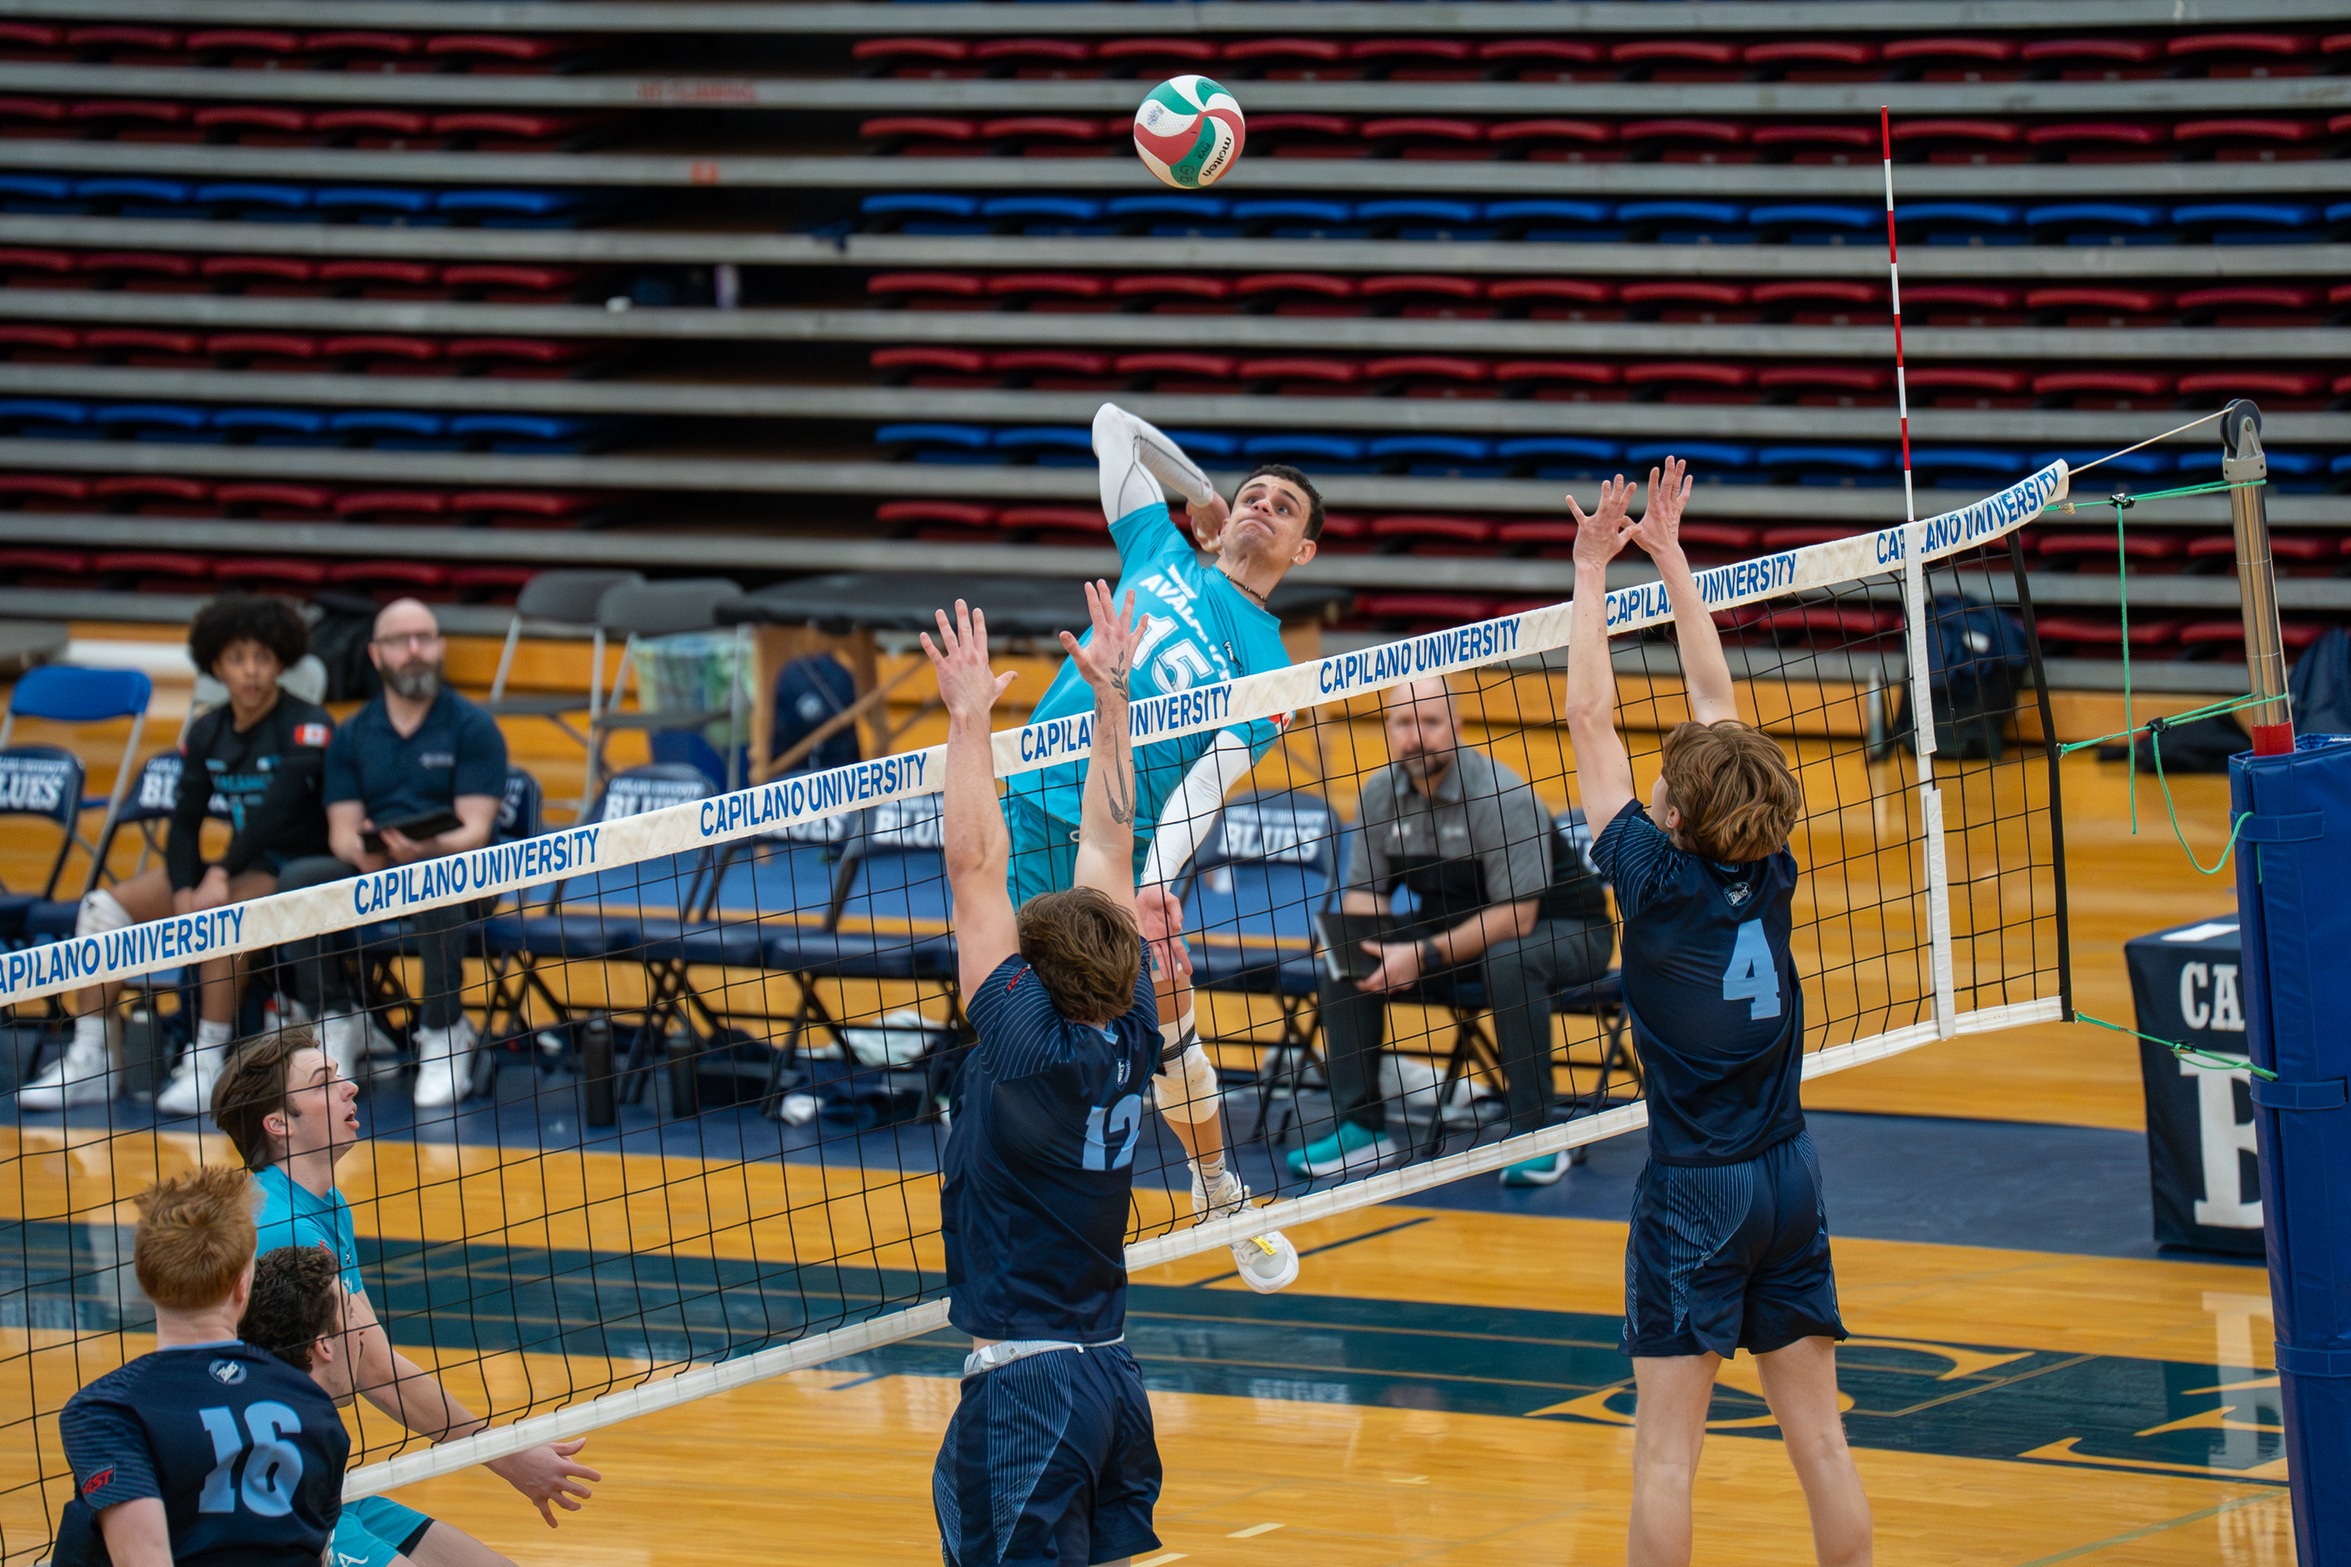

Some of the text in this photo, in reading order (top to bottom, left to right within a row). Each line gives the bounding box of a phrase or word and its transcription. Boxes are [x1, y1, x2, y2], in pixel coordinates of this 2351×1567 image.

[1202, 137, 1232, 177] molten
[1964, 467, 2059, 541] UNIVERSITY
[1606, 583, 1673, 627] CAPILA
[1132, 612, 1215, 694] 15
[1319, 617, 1521, 694] CAPILANO UNIVERSITY
[1021, 684, 1232, 762] CAPILA NIVERSITY
[700, 781, 804, 837] CAPILANO
[807, 752, 927, 812] UNIVERSITY
[871, 809, 944, 848] BLU
[354, 827, 600, 916] CAPILANO UNIVERSITY
[1217, 821, 1321, 863] BLUES
[105, 906, 244, 971] UNIVERSITY
[1722, 918, 1781, 1020] 4
[2179, 960, 2246, 1032] CA
[1082, 1093, 1142, 1171] 12
[198, 1400, 304, 1518] 16
